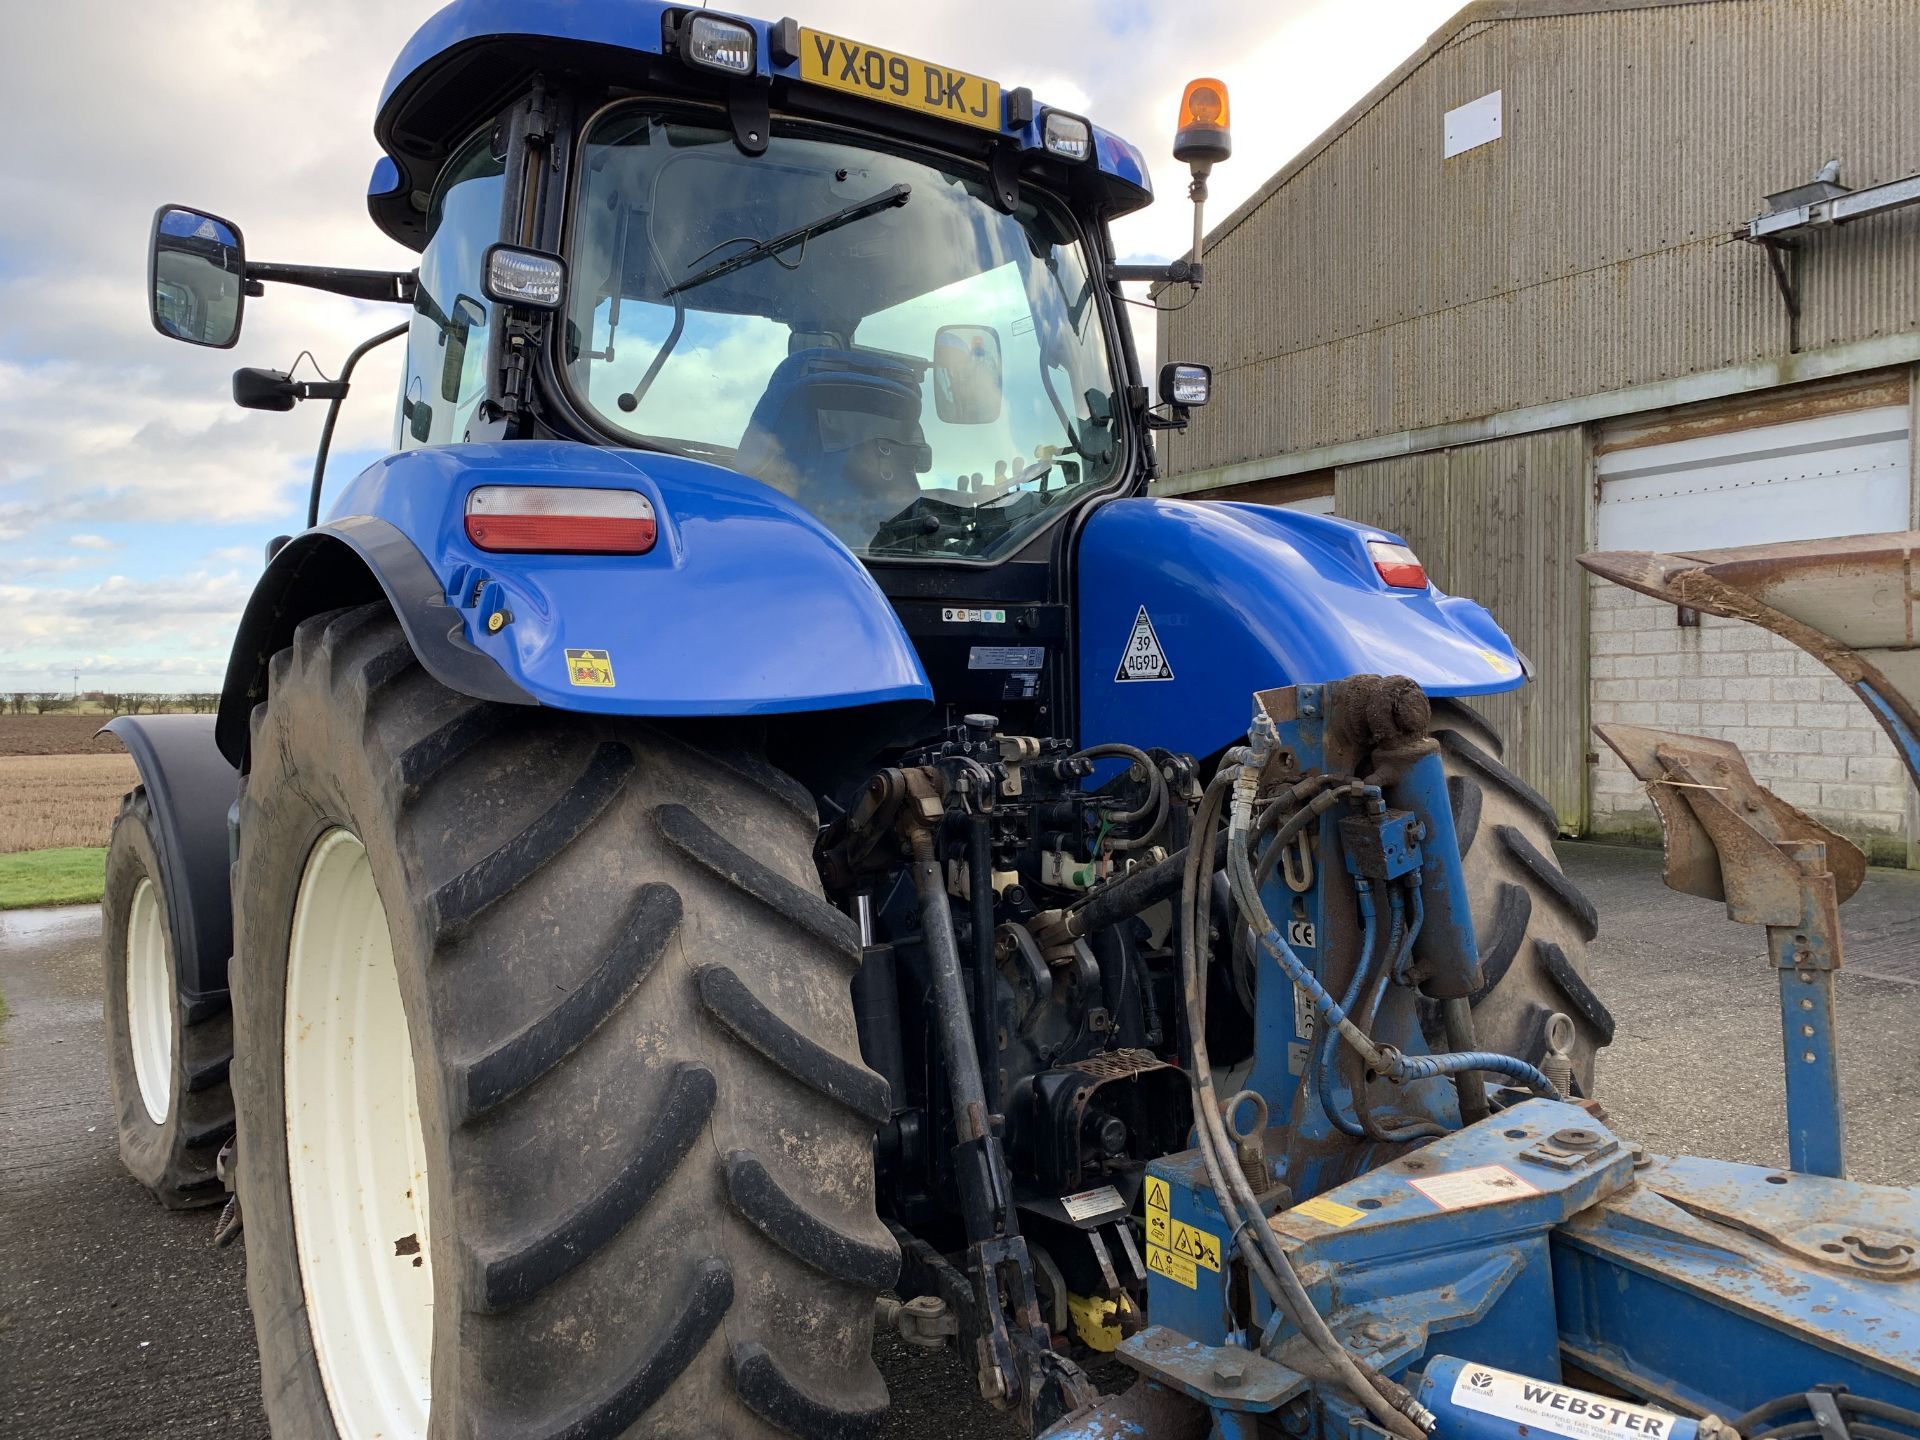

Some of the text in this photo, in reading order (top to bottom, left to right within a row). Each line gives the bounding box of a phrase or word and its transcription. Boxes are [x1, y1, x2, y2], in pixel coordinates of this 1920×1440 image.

[814, 35, 988, 118] YX09 DKJ
[1136, 636, 1151, 651] 39
[1128, 655, 1158, 670] AG9D
[1292, 923, 1312, 946] CE
[1523, 1384, 1664, 1437] WEBSTER
